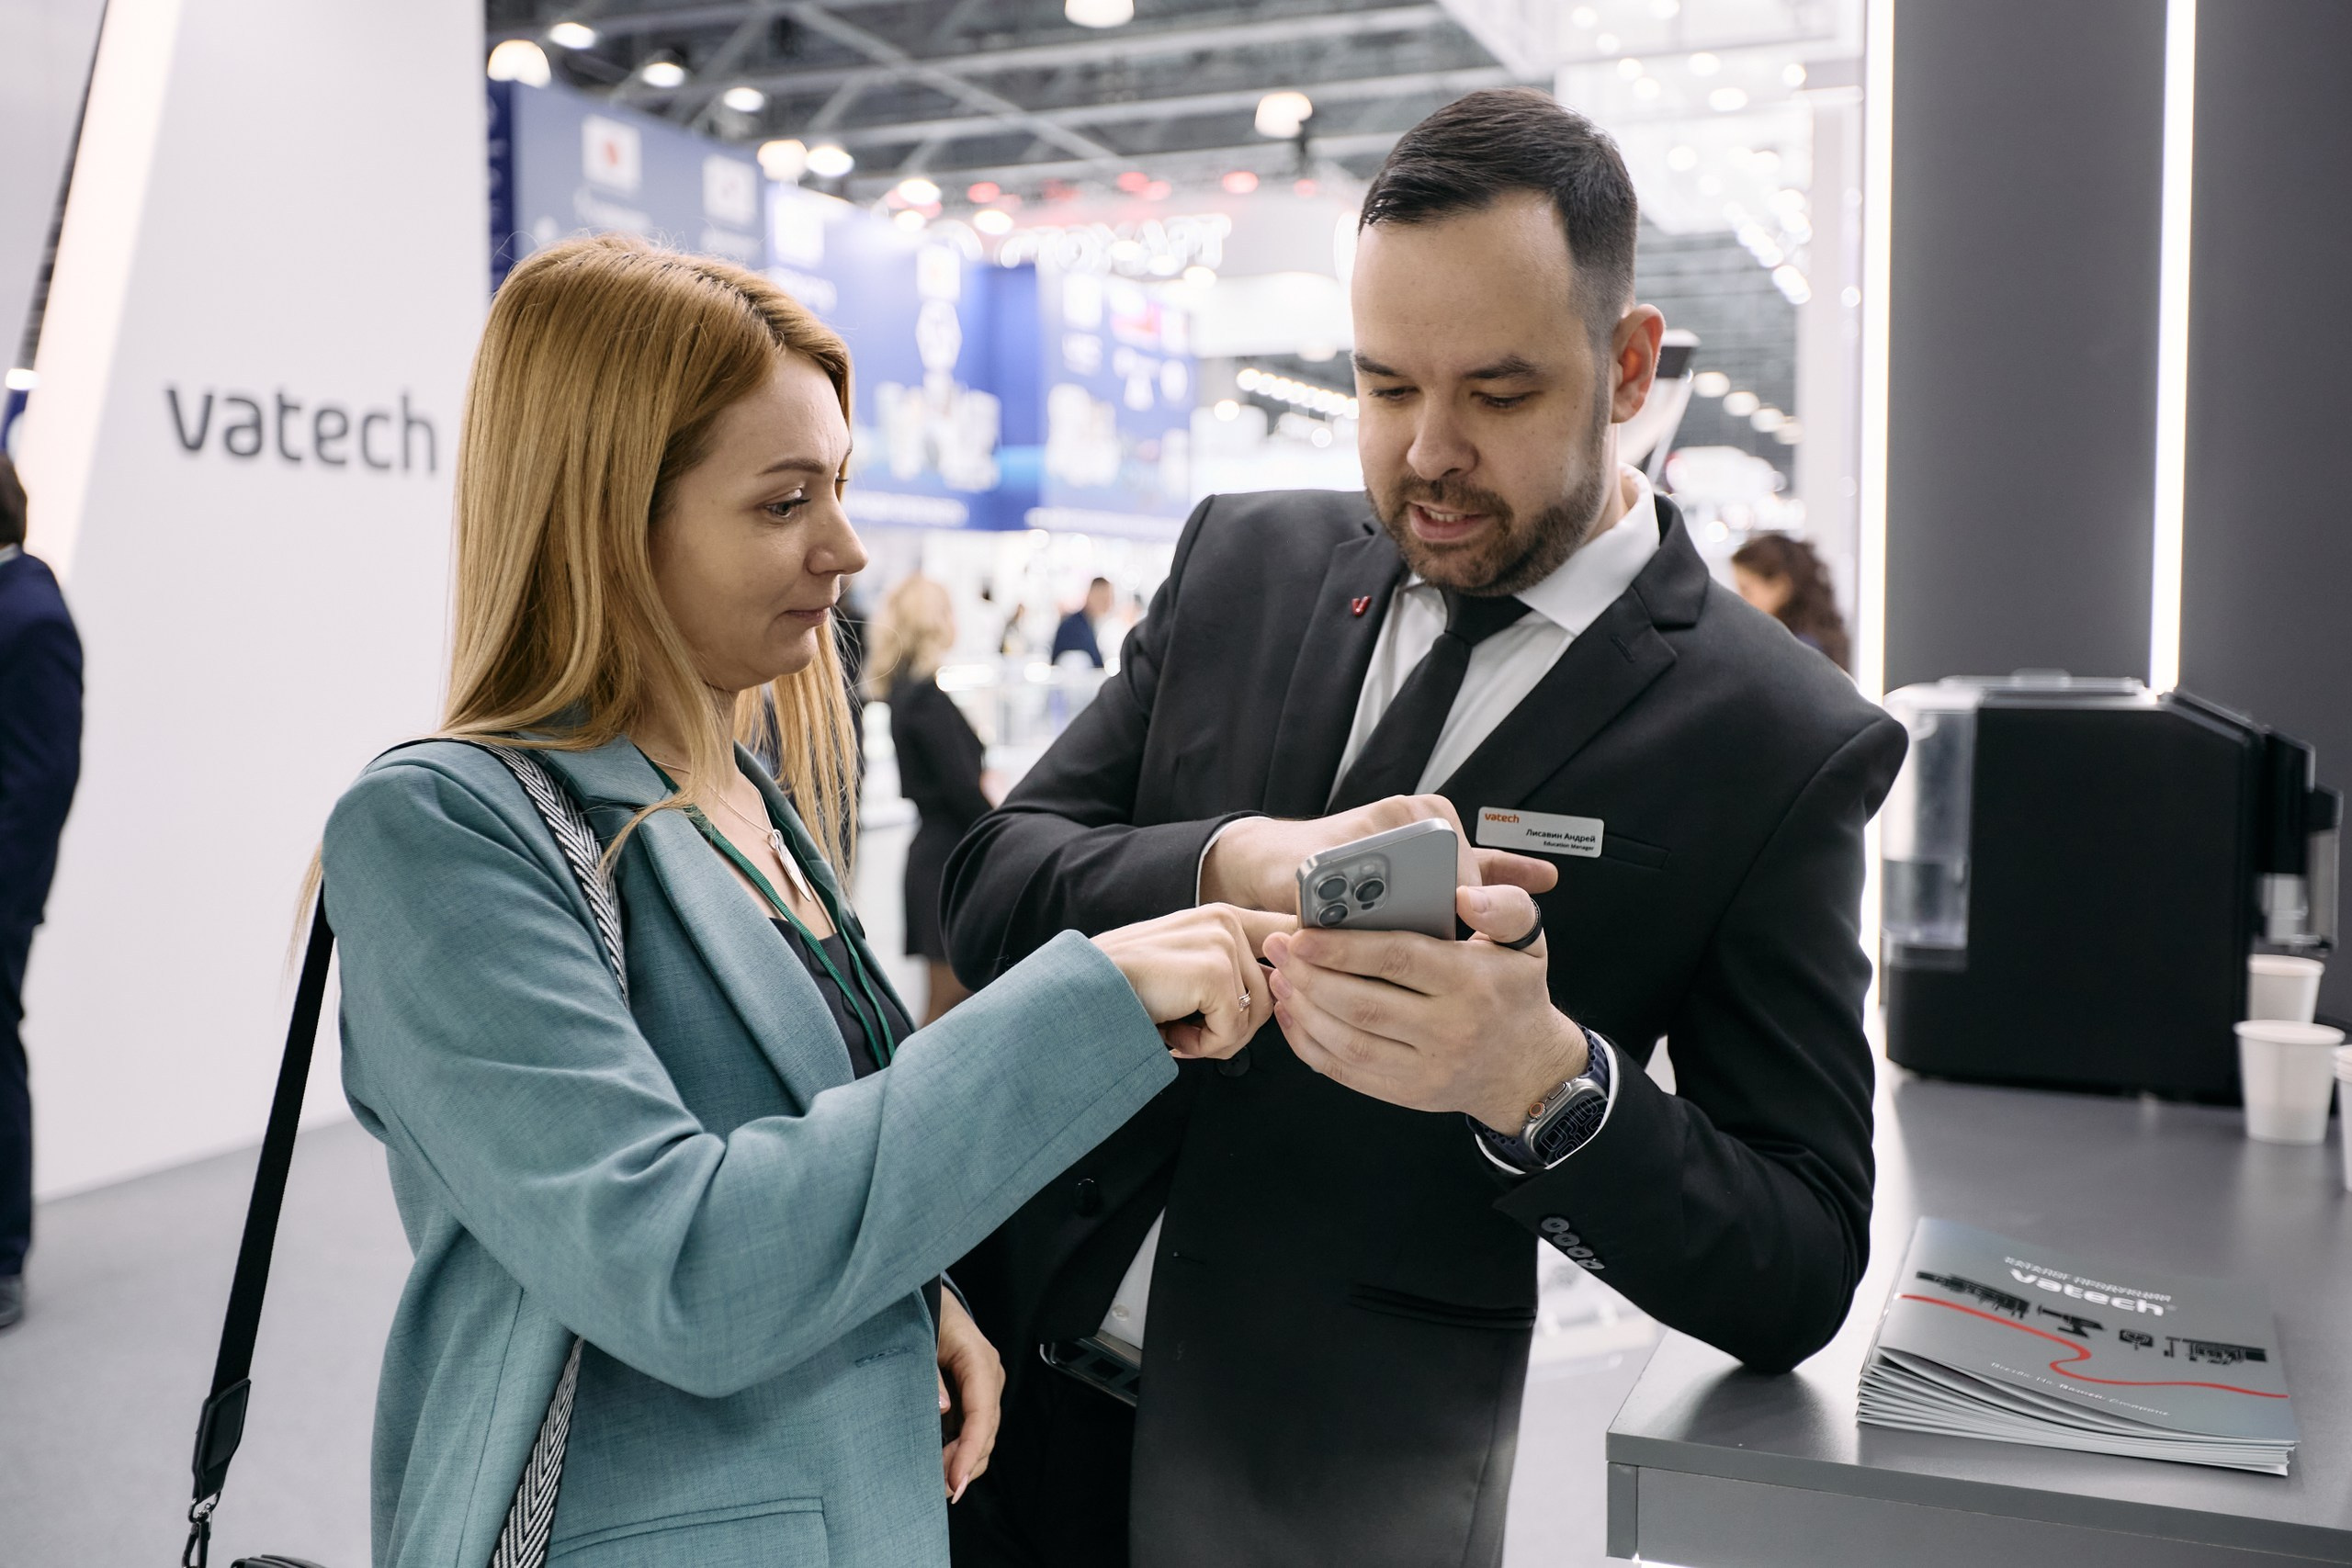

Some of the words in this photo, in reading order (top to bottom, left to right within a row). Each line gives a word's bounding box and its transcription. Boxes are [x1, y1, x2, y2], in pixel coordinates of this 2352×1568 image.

[165, 387, 438, 473] vatech
[1484, 813, 1520, 824] vatech
[1525, 829, 1562, 840] Лисавин
[1564, 832, 1596, 843] Андрей
[1544, 840, 1569, 849] Education
[1570, 843, 1594, 852] Manager
[2009, 1268, 2165, 1316] vatech
